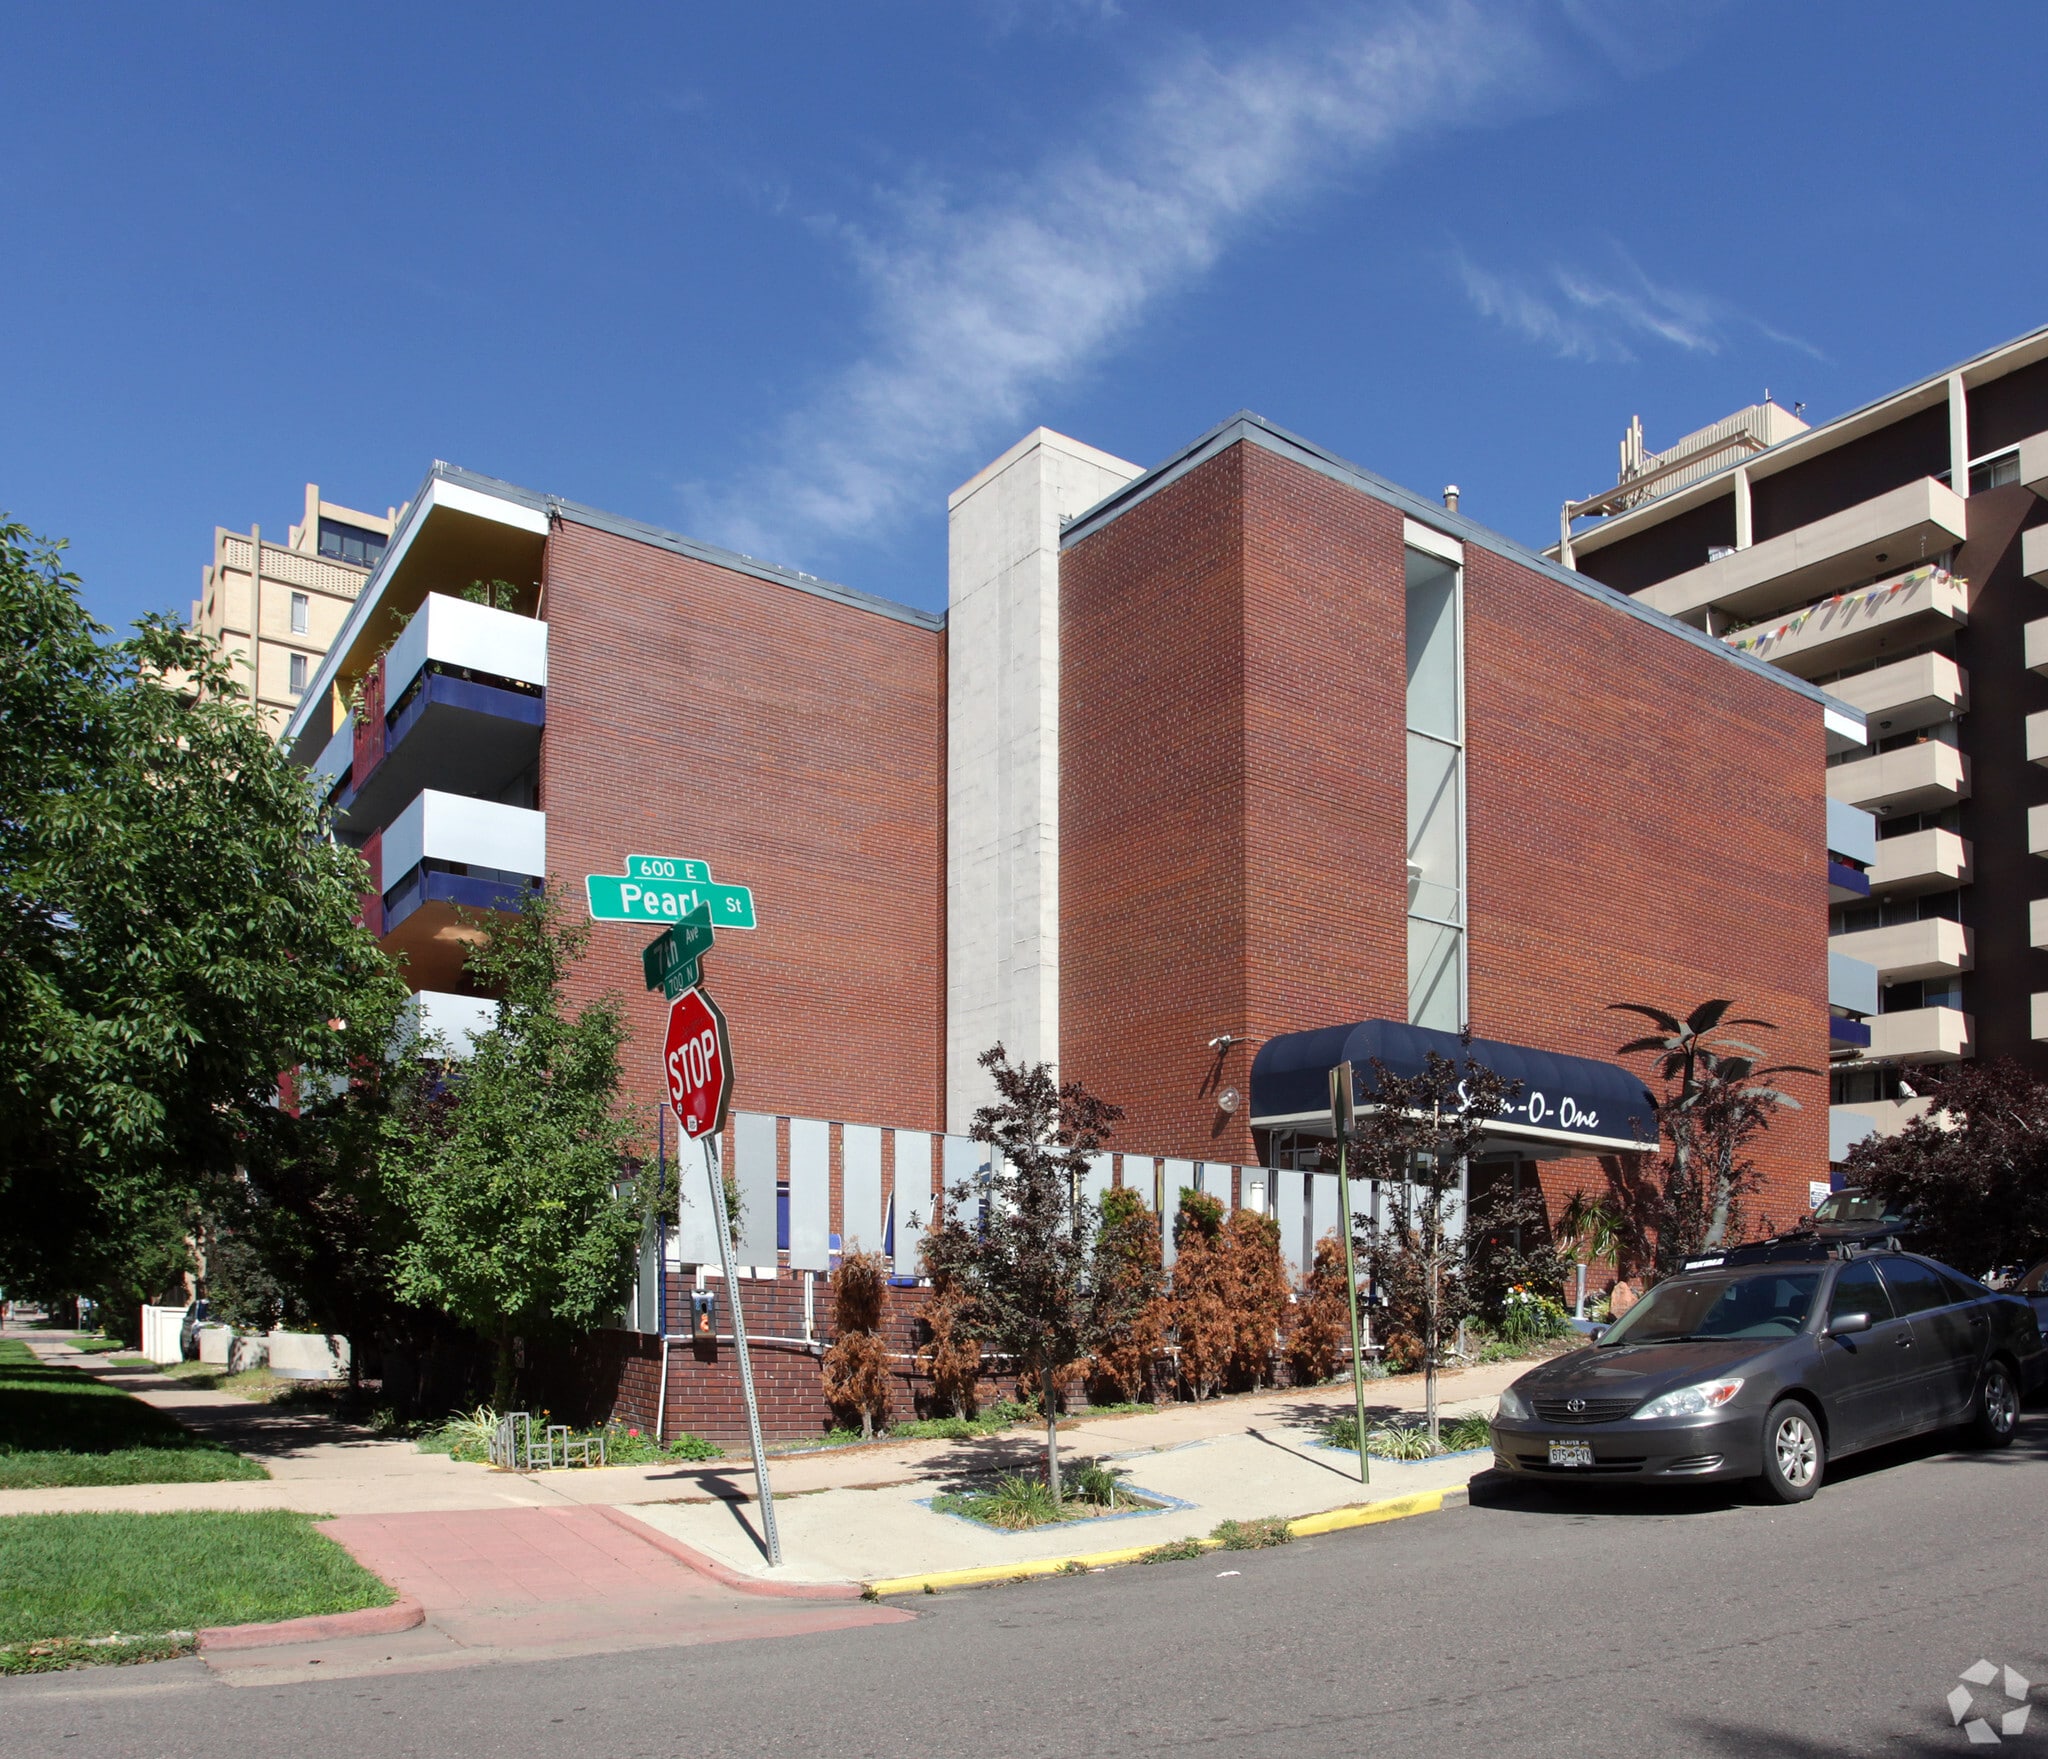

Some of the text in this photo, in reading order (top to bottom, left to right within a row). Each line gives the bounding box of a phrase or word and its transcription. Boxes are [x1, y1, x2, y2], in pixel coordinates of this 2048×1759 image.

[641, 861, 697, 879] 600 E
[620, 883, 743, 917] Pearl St
[653, 926, 699, 975] 7th Ave
[668, 964, 694, 995] 700 N
[668, 1029, 715, 1101] STOP
[1457, 1079, 1599, 1128] Sn-O-One
